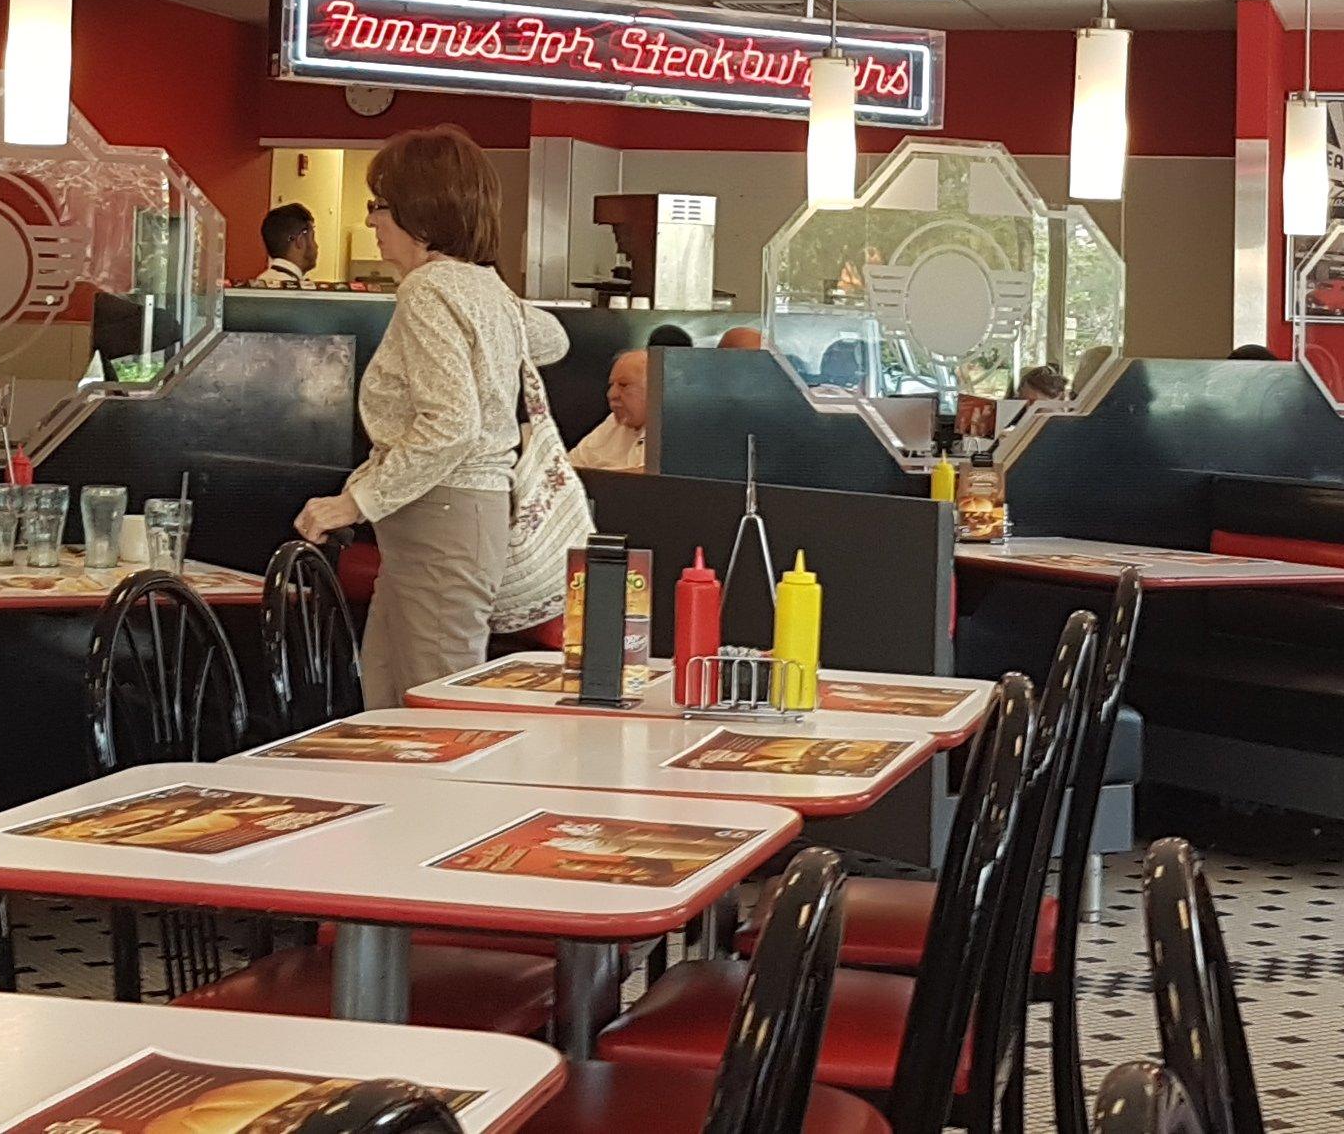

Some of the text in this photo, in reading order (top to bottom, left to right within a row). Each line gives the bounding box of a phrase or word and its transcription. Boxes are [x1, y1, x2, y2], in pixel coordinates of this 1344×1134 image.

[327, 0, 908, 95] Famous For Steakburrs
